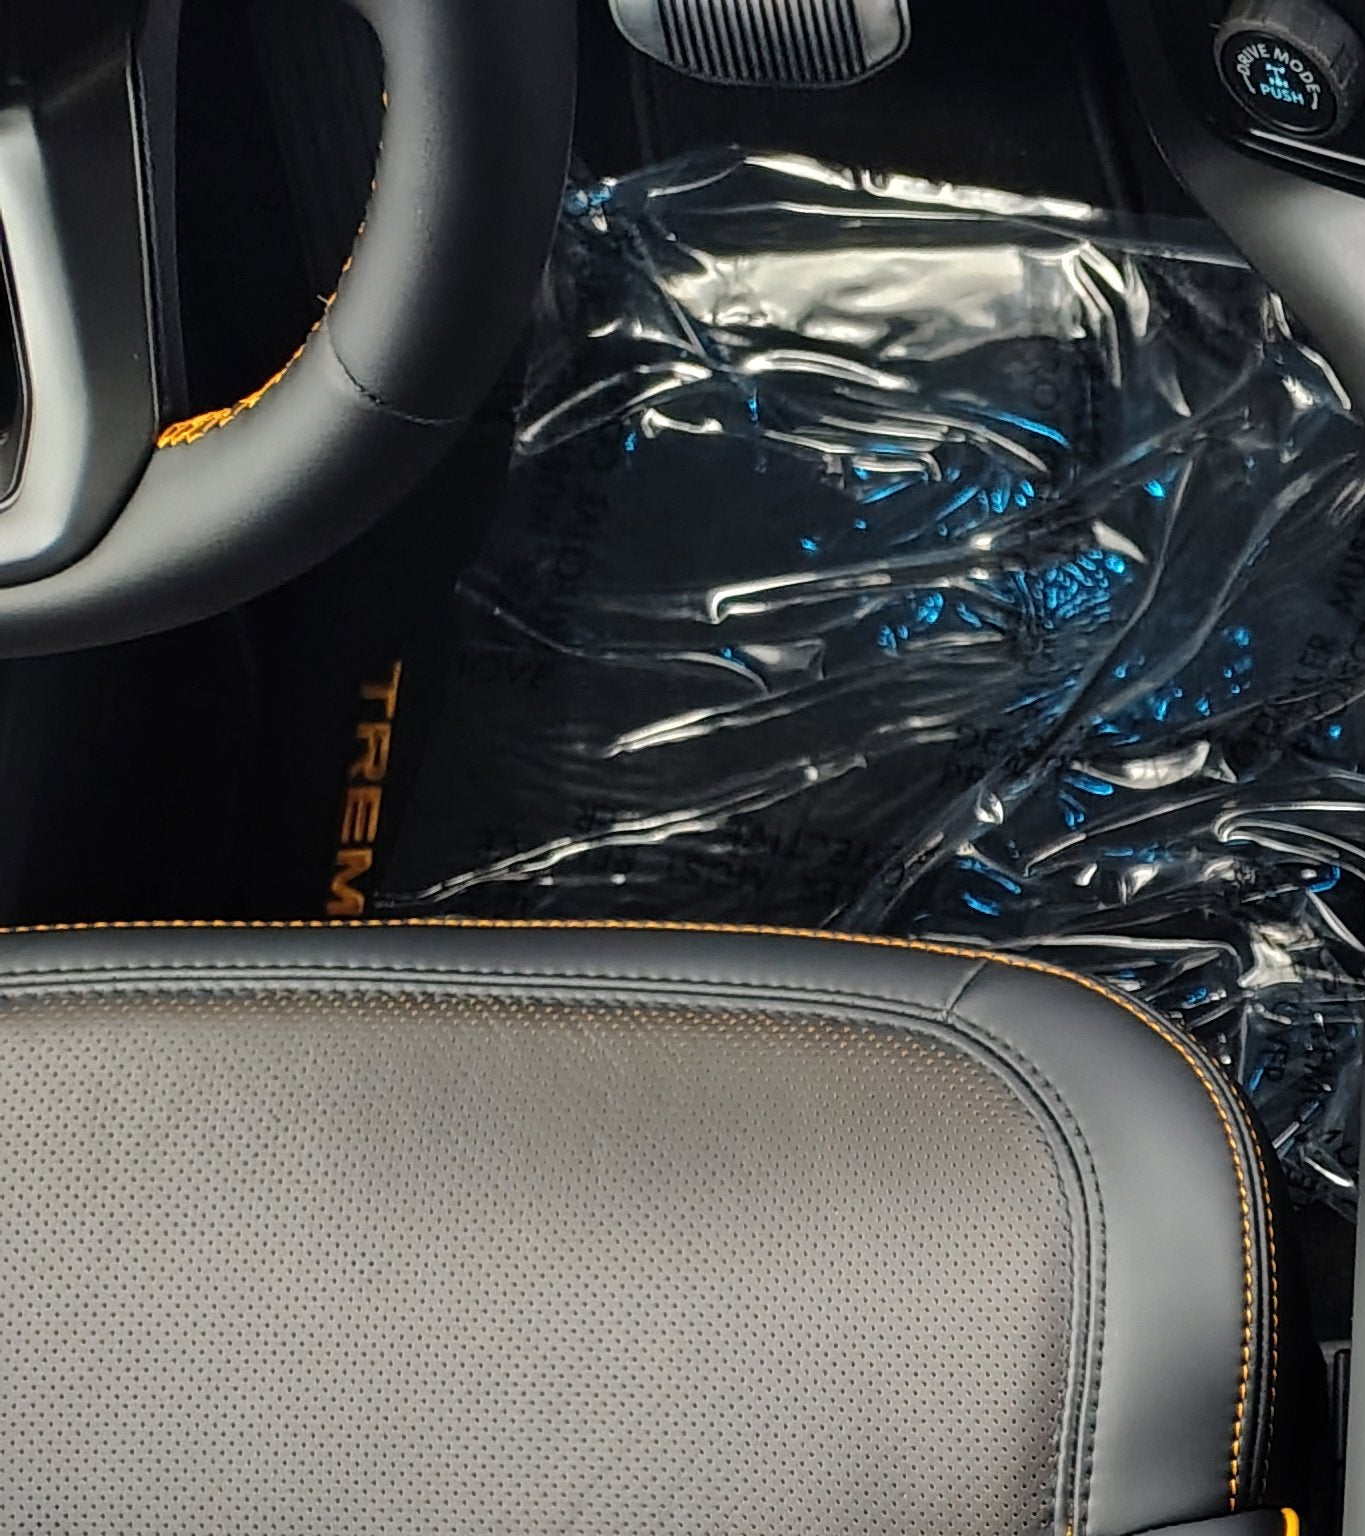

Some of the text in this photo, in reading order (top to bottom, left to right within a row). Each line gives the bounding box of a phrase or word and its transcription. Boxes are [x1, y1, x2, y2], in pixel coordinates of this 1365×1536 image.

[1237, 44, 1320, 93] DRIVE MODE
[1259, 83, 1305, 106] PUSH
